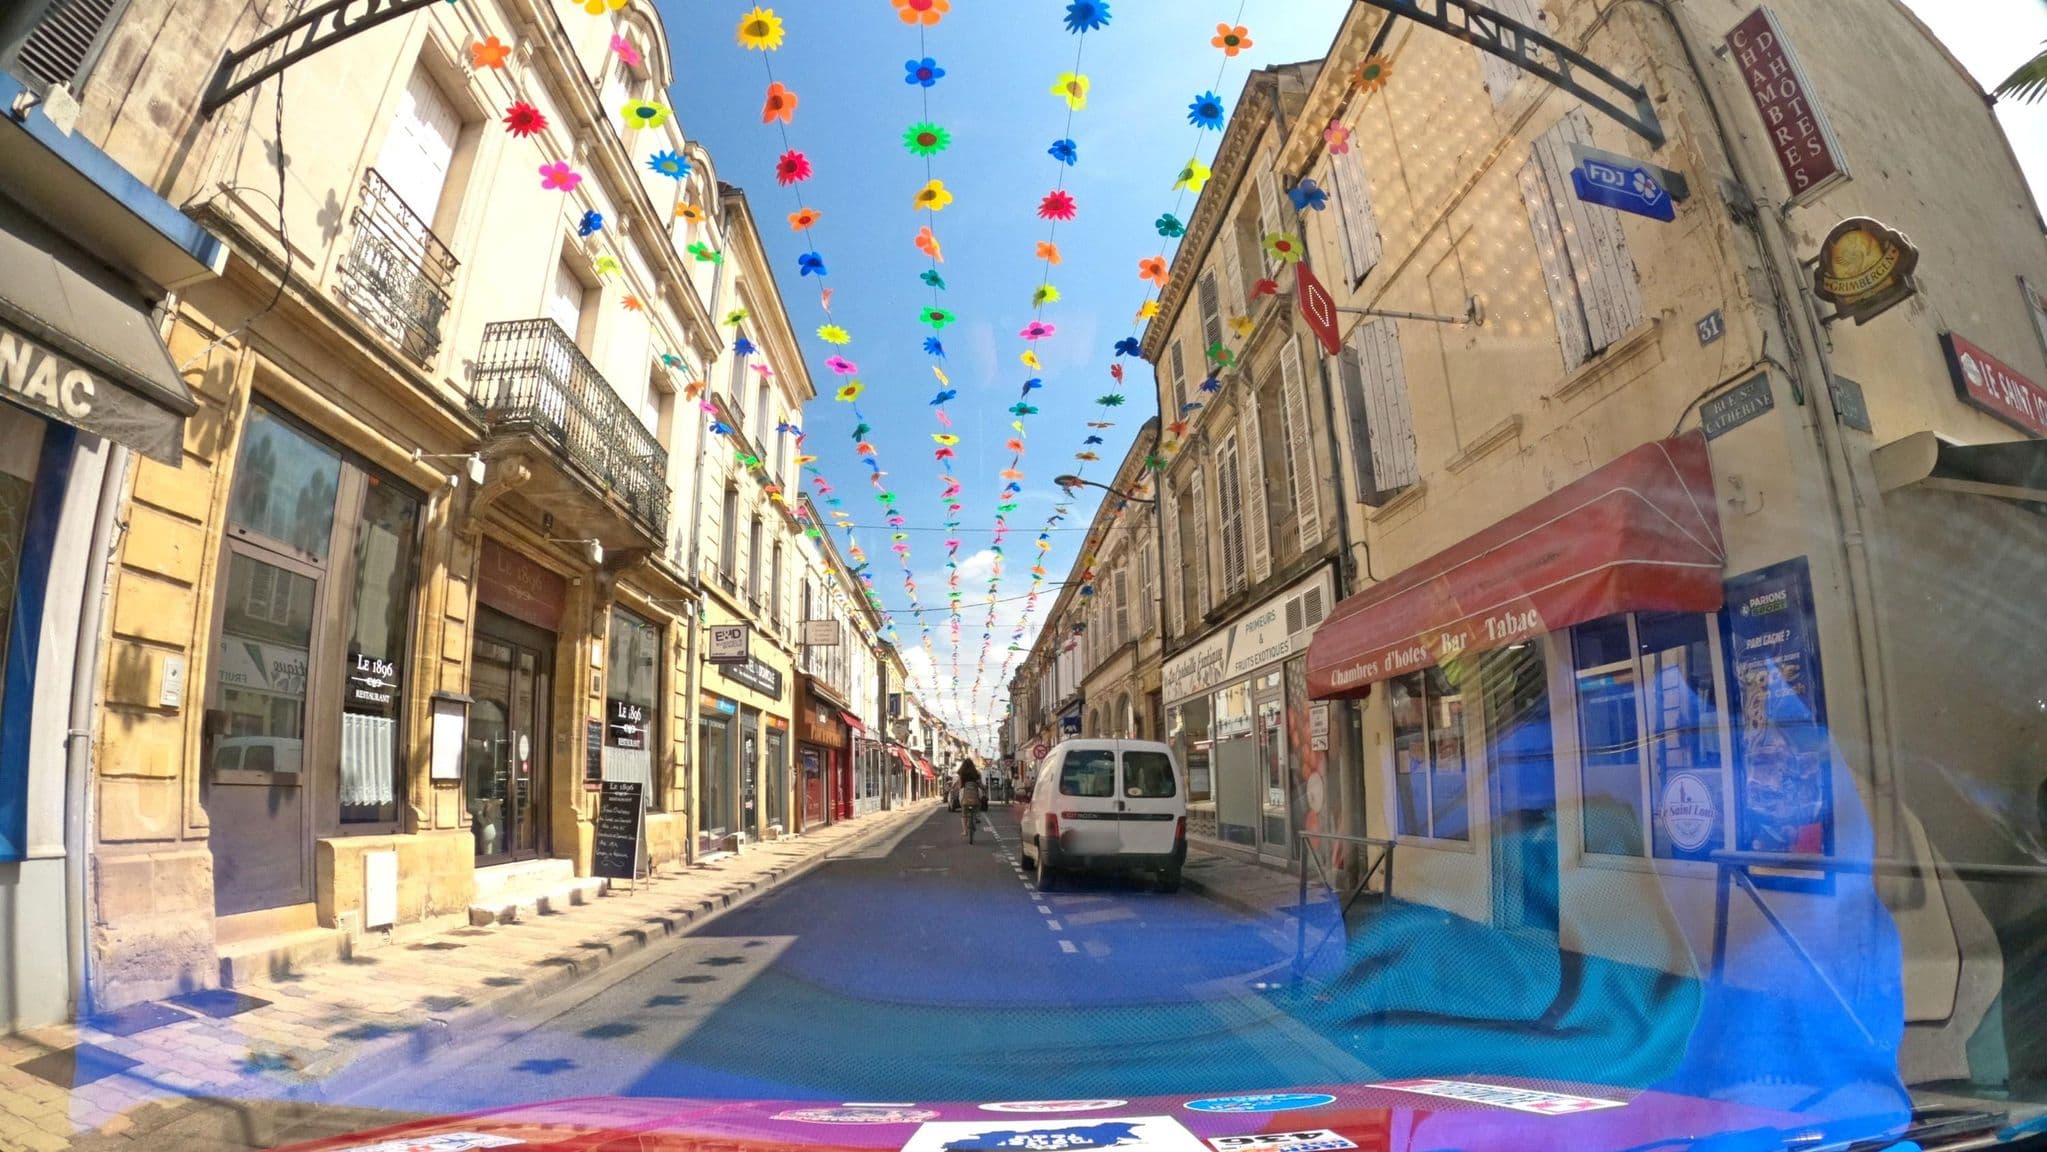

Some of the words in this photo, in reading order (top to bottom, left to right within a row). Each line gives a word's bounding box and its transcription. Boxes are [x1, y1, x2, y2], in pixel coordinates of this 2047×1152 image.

[1733, 30, 1809, 188] CHAMBRES
[1589, 164, 1625, 187] FDJ
[1829, 255, 1896, 292] GRIMBERGEN
[1699, 315, 1720, 341] 31
[1979, 360, 2000, 400] LE
[1998, 371, 2035, 420] SAINT
[1706, 391, 1772, 434] CATHERINE
[1713, 393, 1737, 414] RUE
[518, 567, 543, 594] 1896
[1749, 589, 1787, 608] PARIONS
[1245, 609, 1277, 634] PRIMEURS
[1235, 656, 1255, 673] FRUITS
[1254, 640, 1289, 664] EXOTIQUES
[1330, 659, 1379, 687] Chambres
[1440, 630, 1468, 655] Bar
[1484, 607, 1538, 641] Tabac
[372, 658, 393, 678] 1896
[355, 689, 391, 704] RESTAURANT
[628, 704, 642, 722] 1896
[620, 783, 634, 792] 1896
